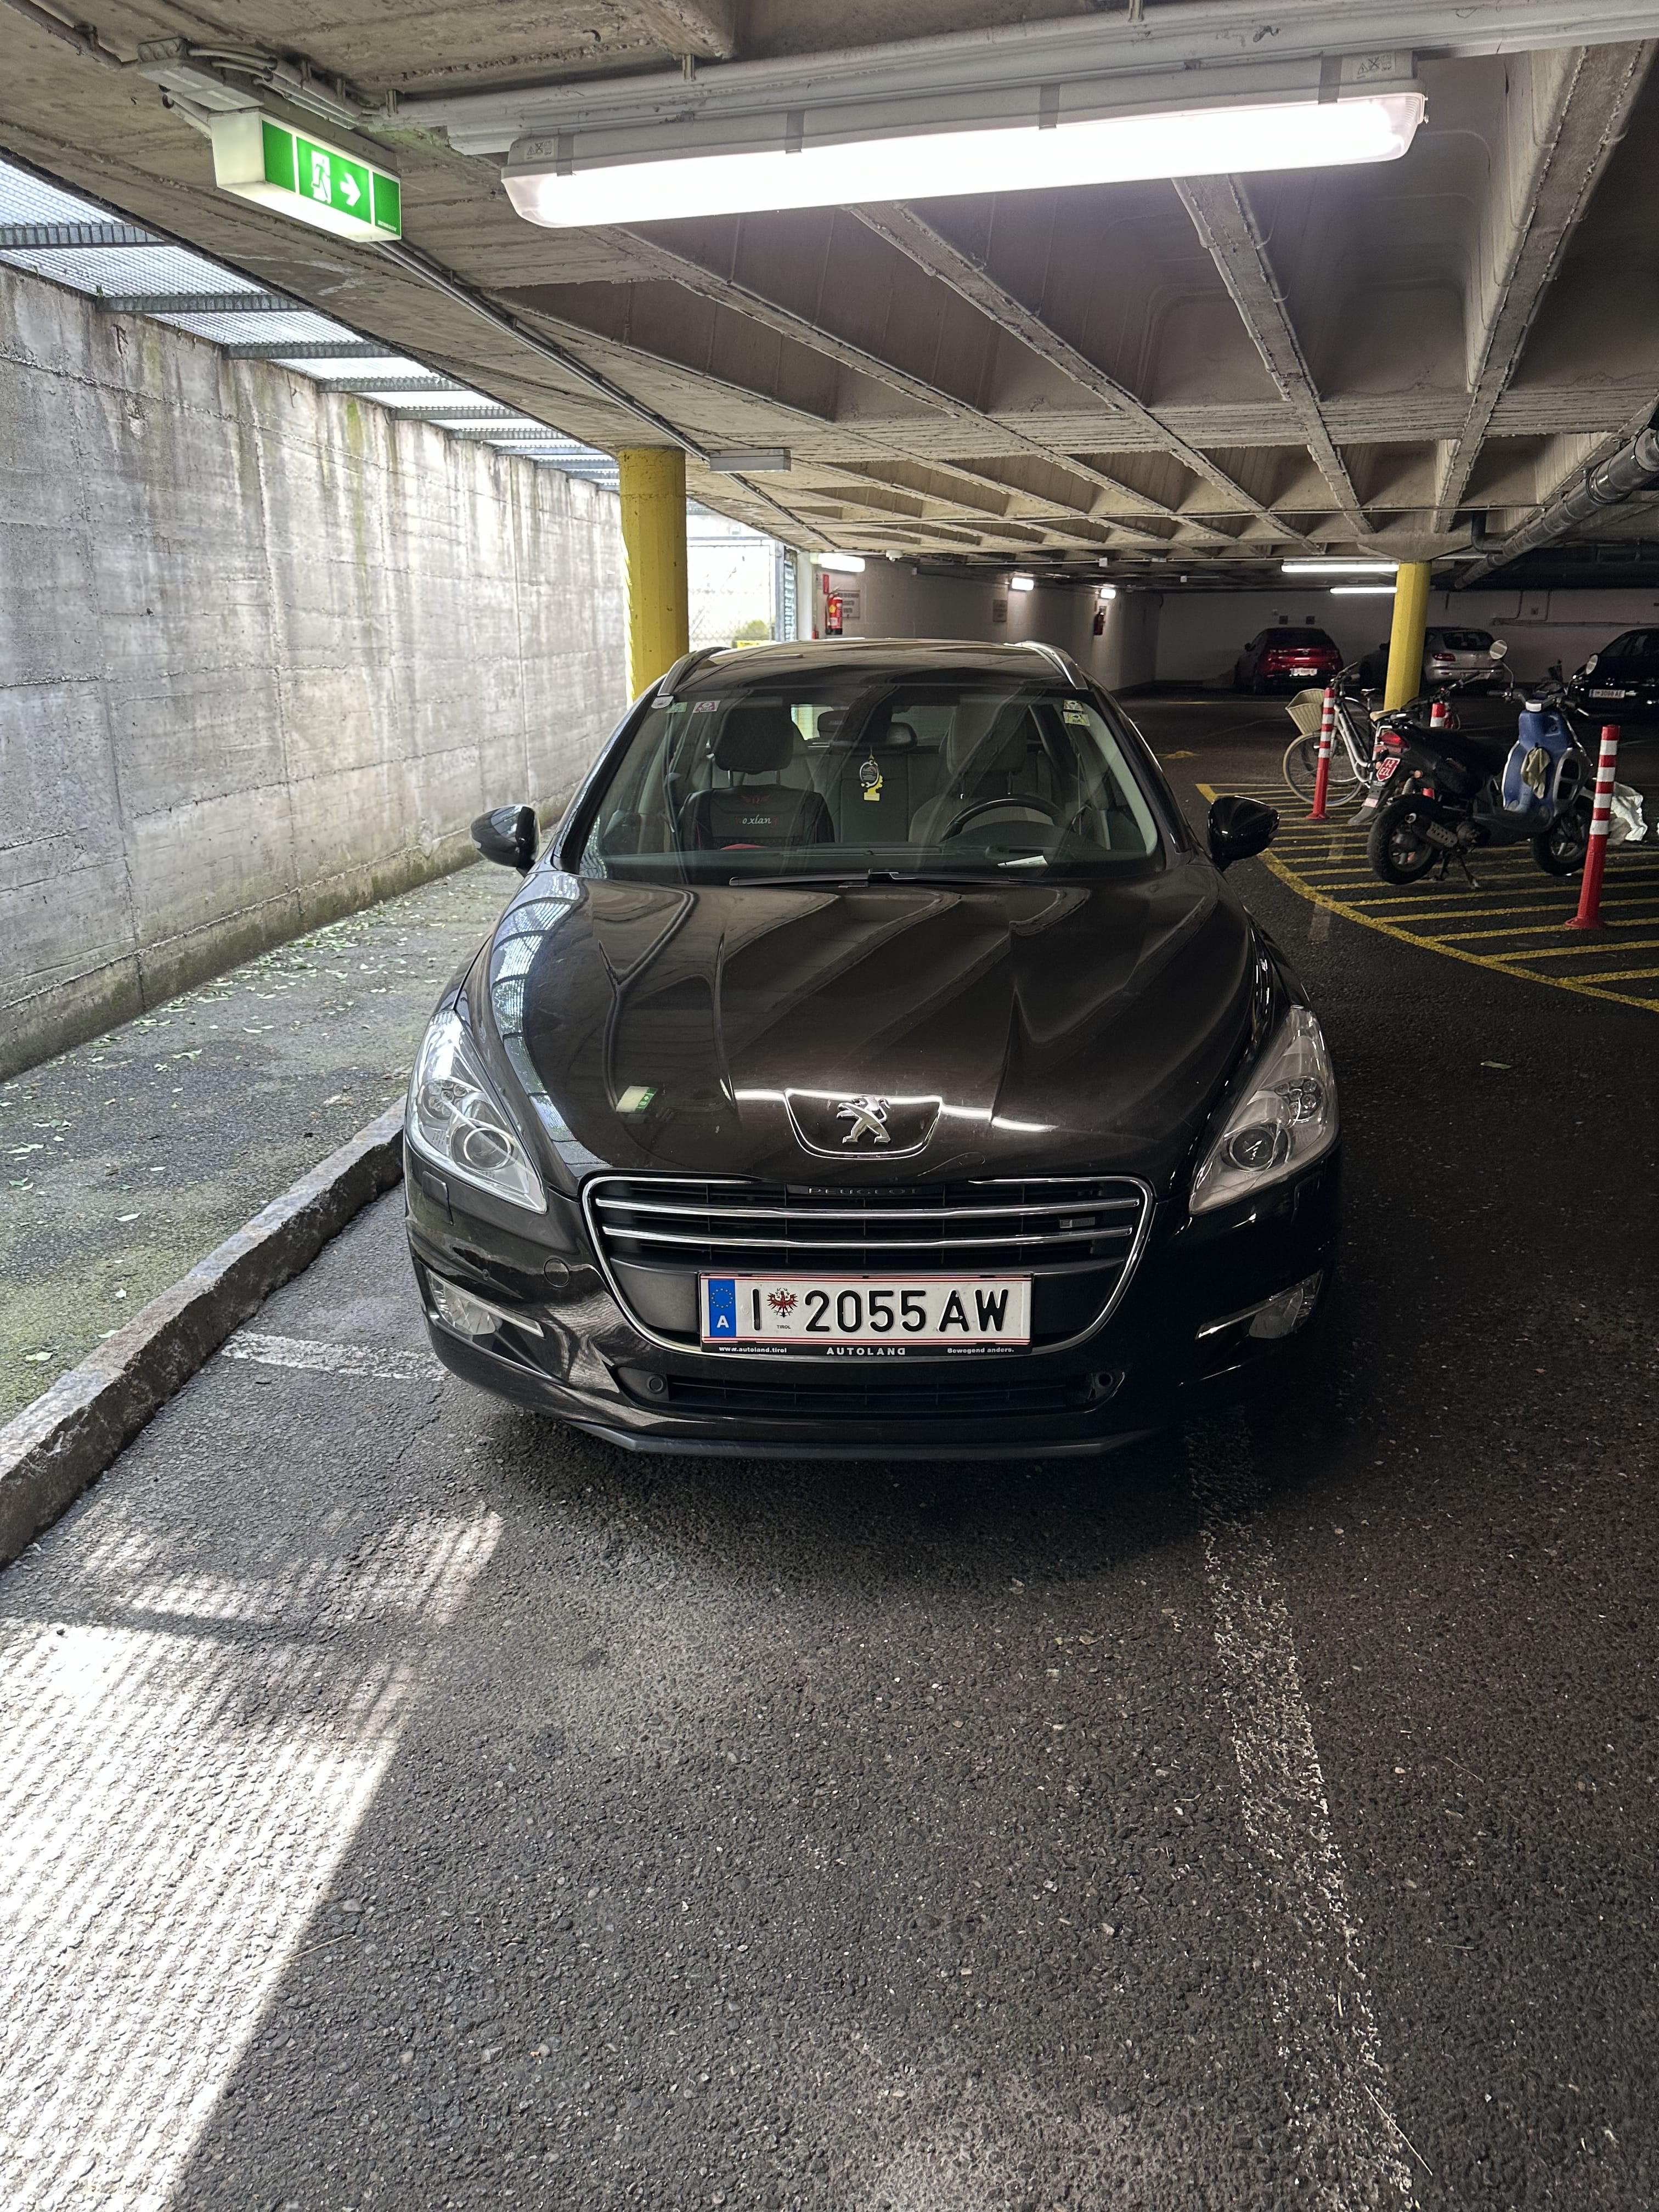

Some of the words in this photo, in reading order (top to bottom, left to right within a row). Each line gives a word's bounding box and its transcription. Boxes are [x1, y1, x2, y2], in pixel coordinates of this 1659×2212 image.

[804, 1289, 926, 1333] 2055
[938, 1289, 1008, 1333] AW
[716, 1315, 729, 1328] A
[826, 1347, 905, 1355] AUTOLAND
